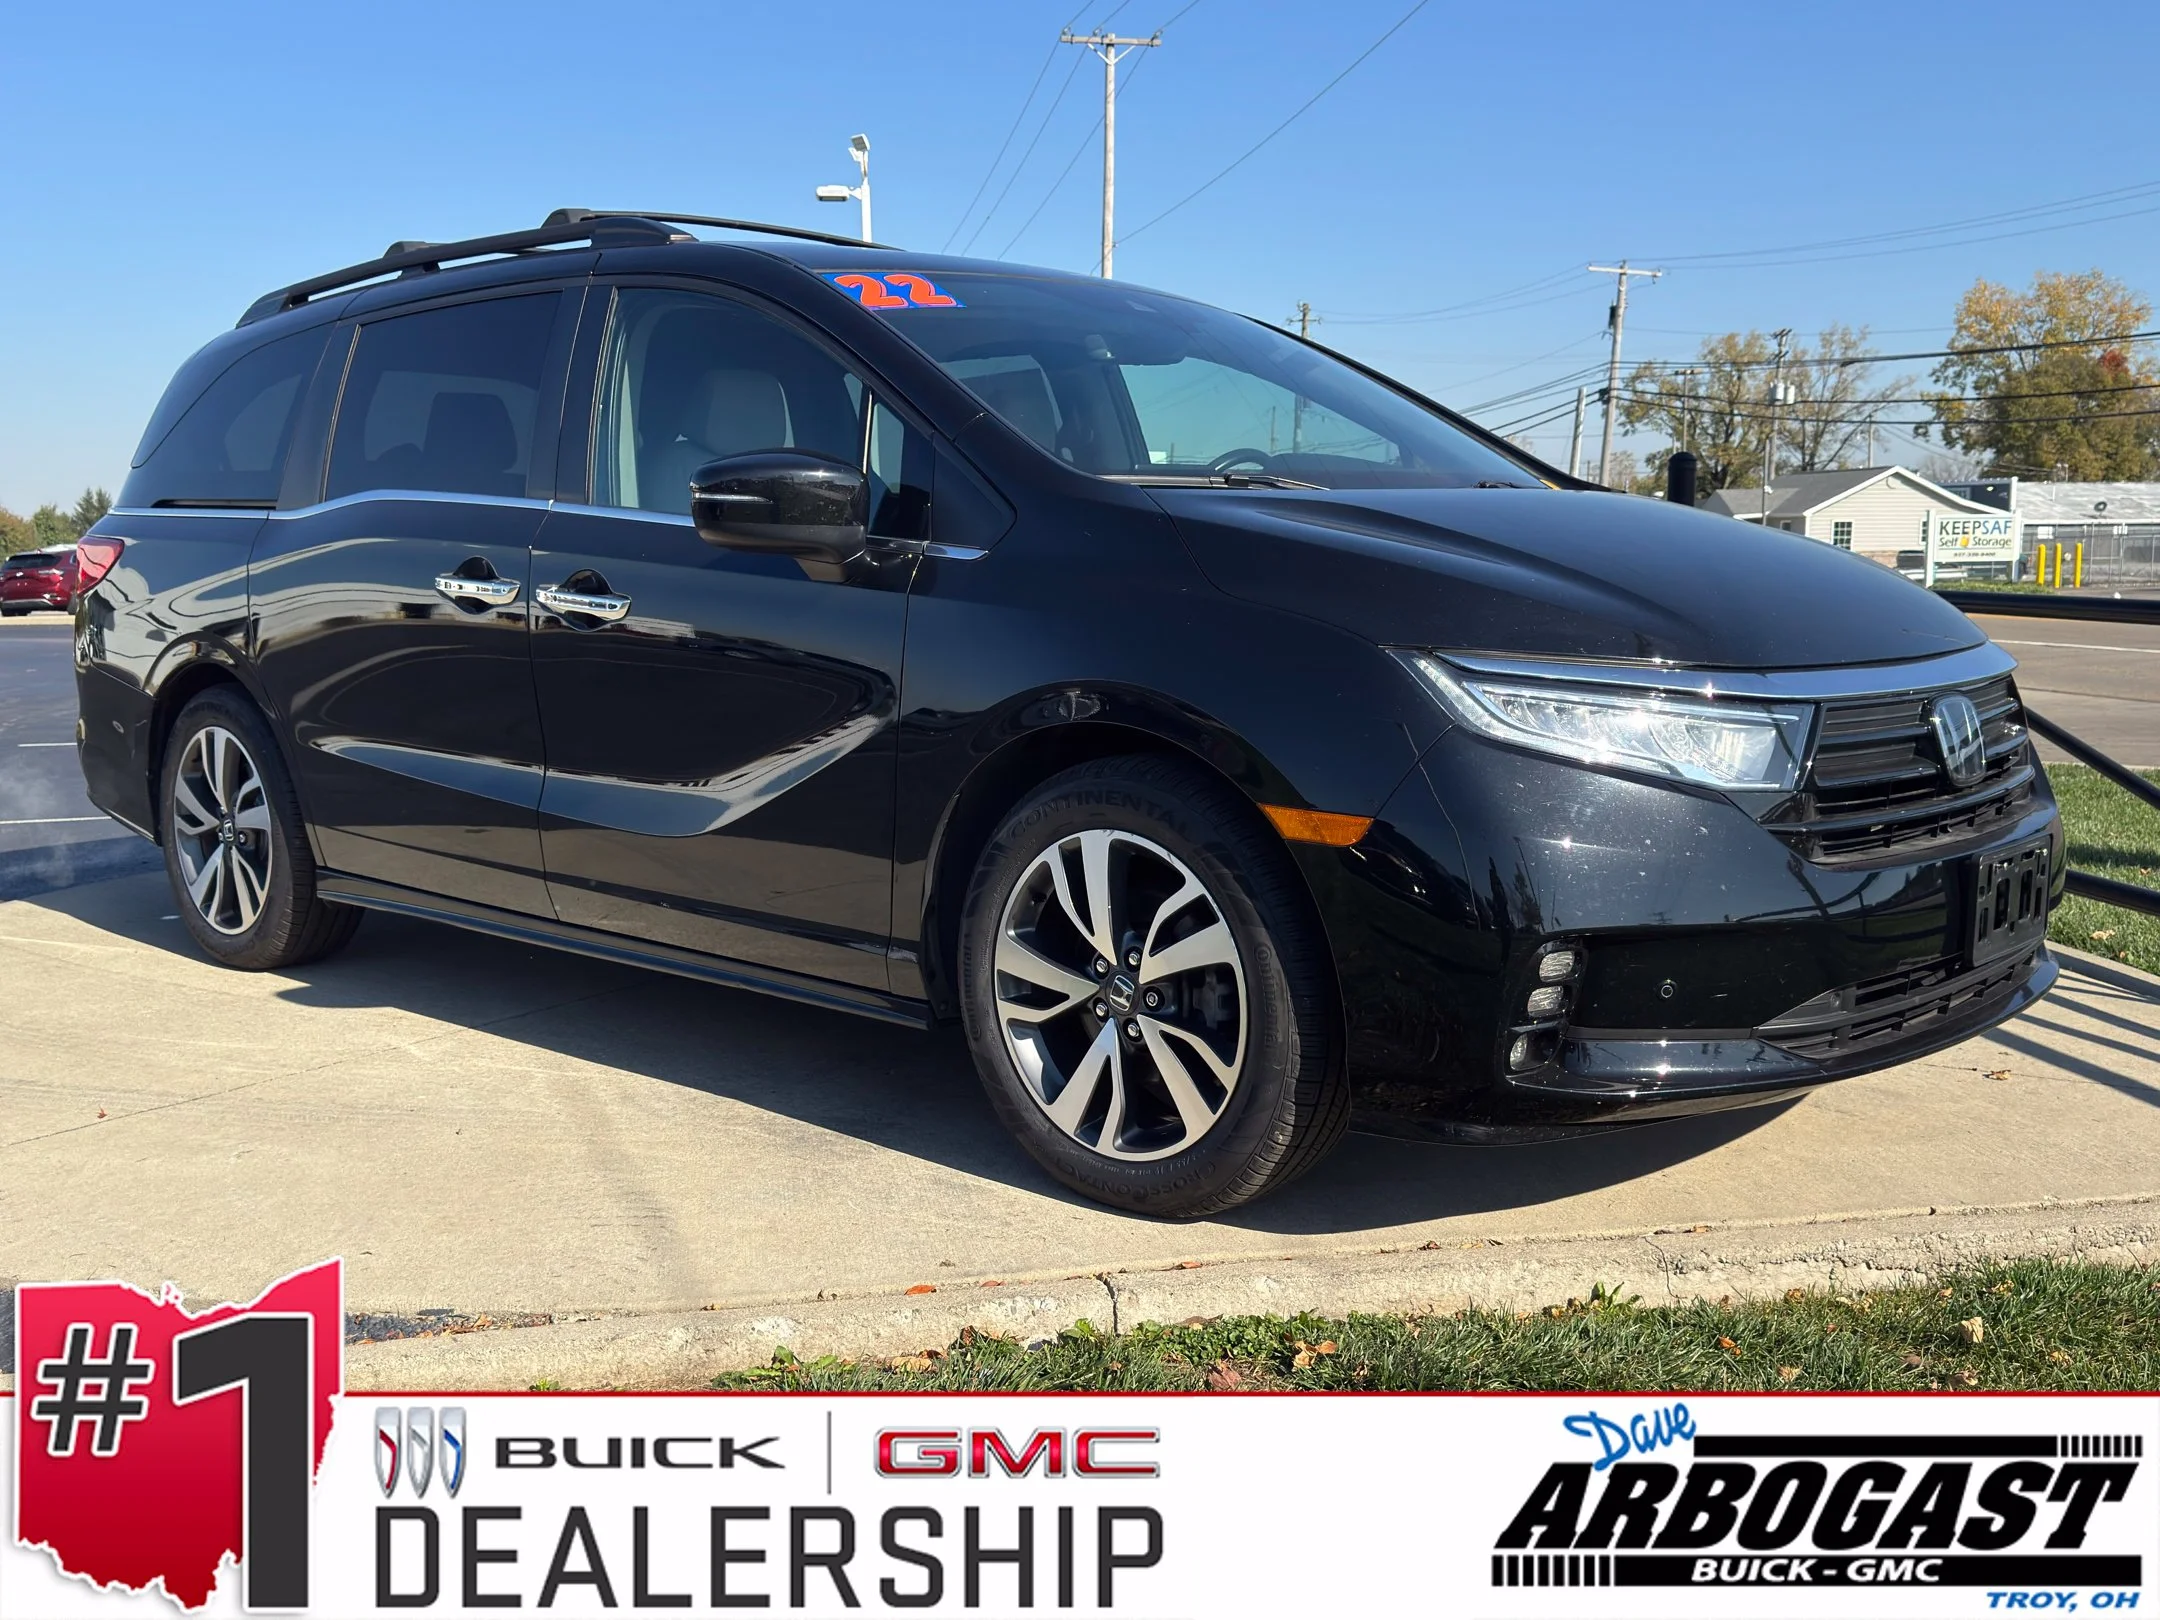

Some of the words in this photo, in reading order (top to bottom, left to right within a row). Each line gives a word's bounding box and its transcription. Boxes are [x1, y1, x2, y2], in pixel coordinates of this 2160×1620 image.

[834, 274, 956, 308] 22
[1938, 536, 1959, 548] Self
[1972, 536, 2012, 549] Storage
[1008, 788, 1191, 841] CONTINENTAL
